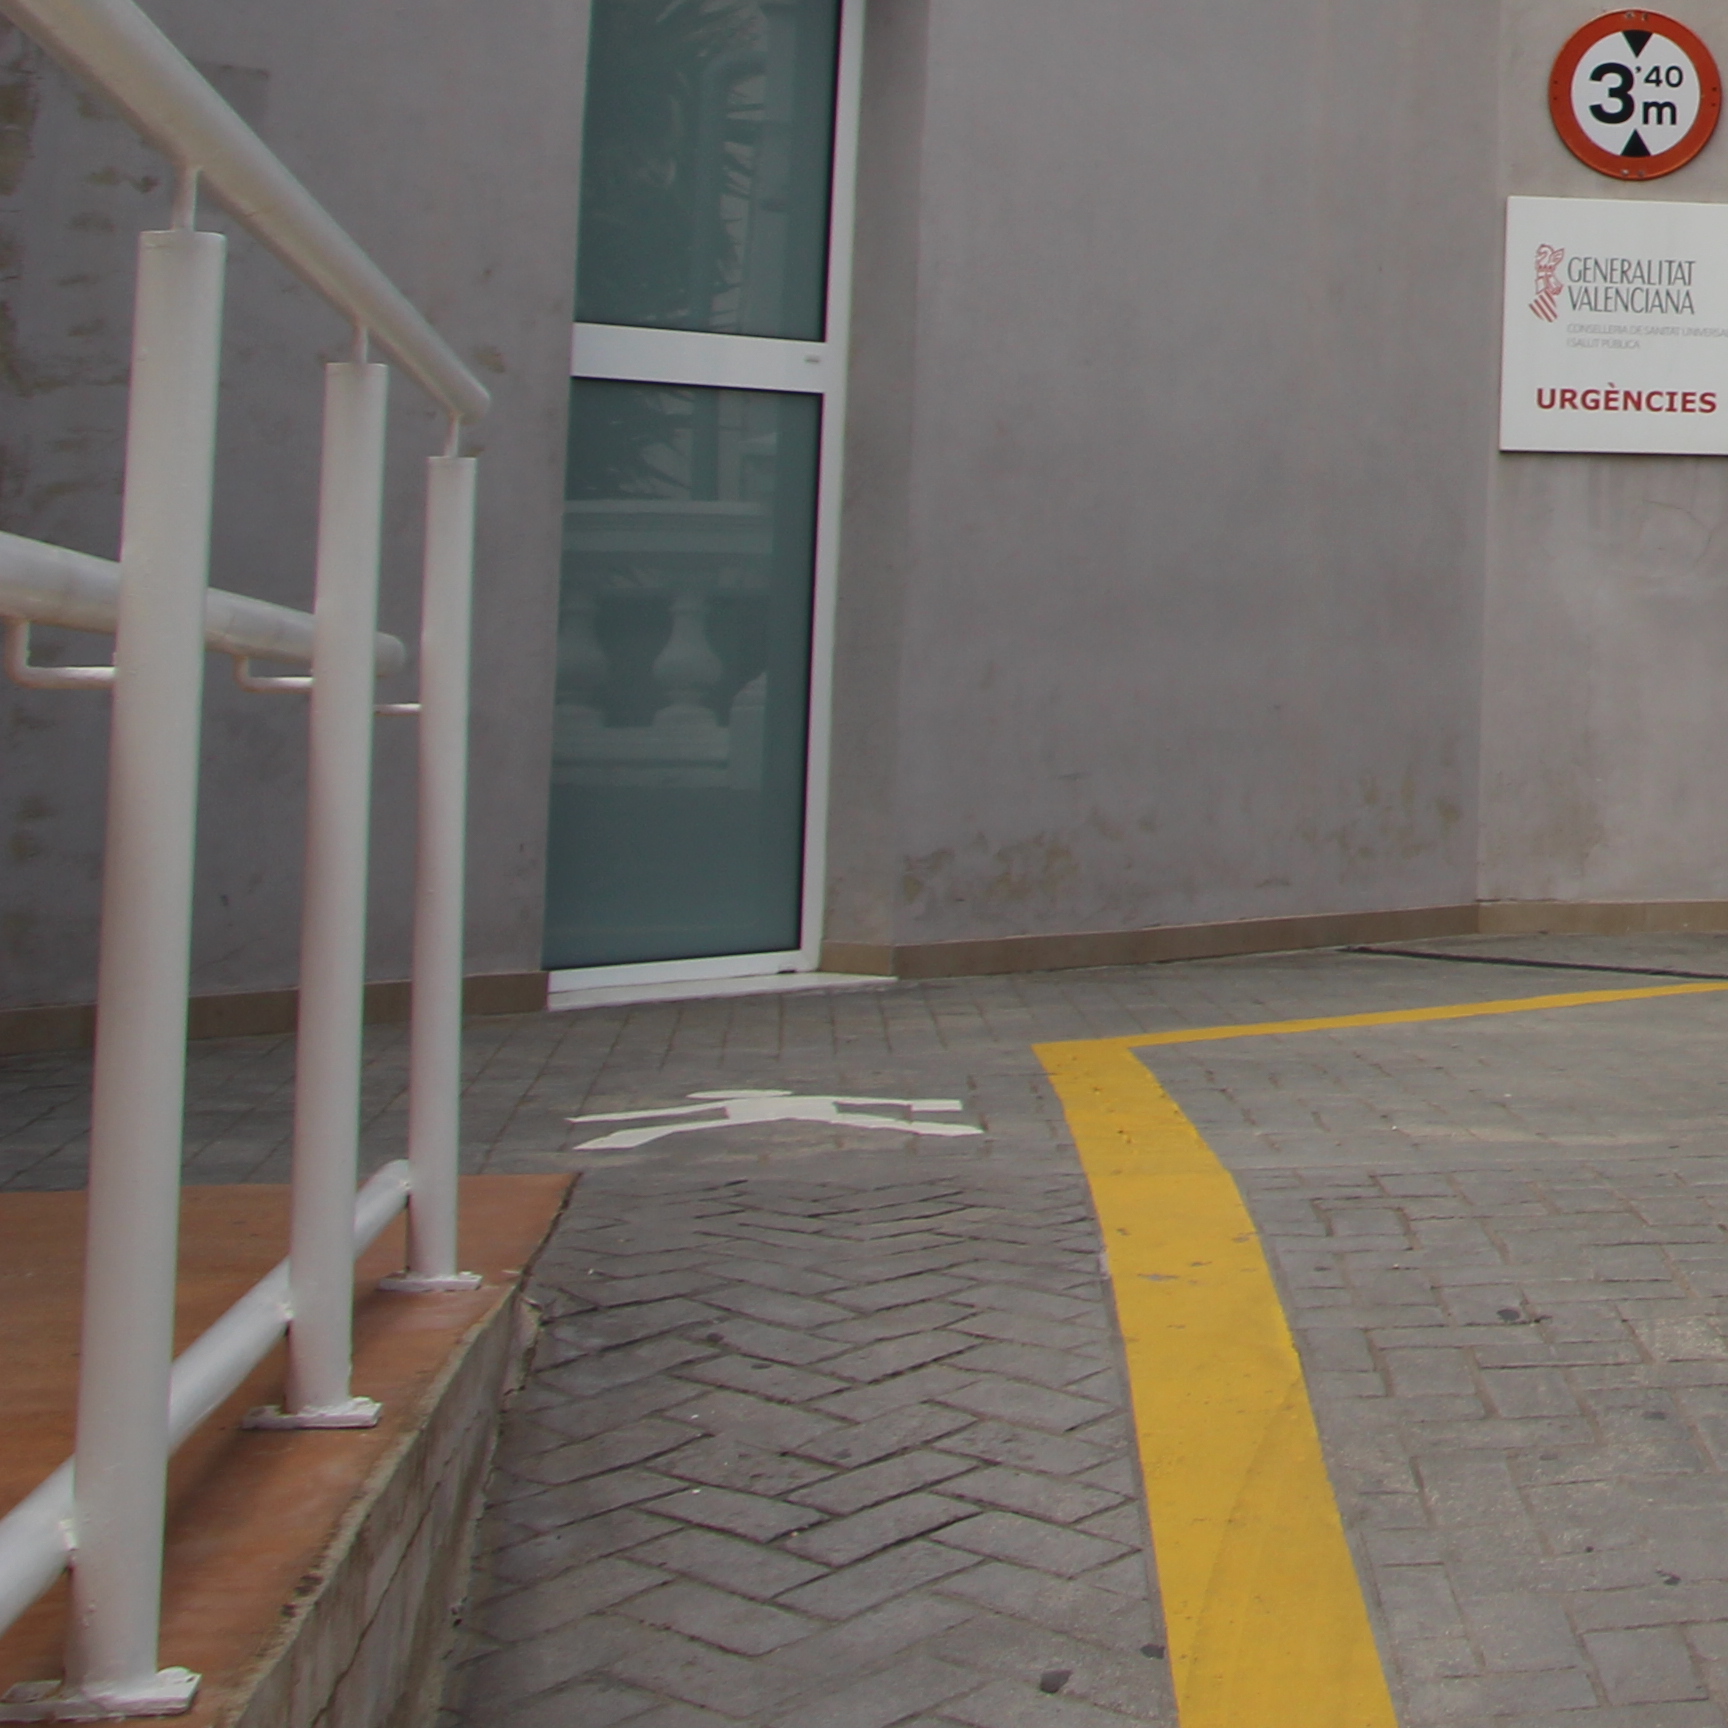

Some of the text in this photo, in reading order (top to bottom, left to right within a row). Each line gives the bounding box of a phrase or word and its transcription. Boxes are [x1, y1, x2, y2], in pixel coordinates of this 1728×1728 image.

[1567, 256, 1696, 286] GENERALITAT
[1568, 285, 1695, 315] VALENCIANA
[1535, 381, 1718, 414] URGÈNCIES
